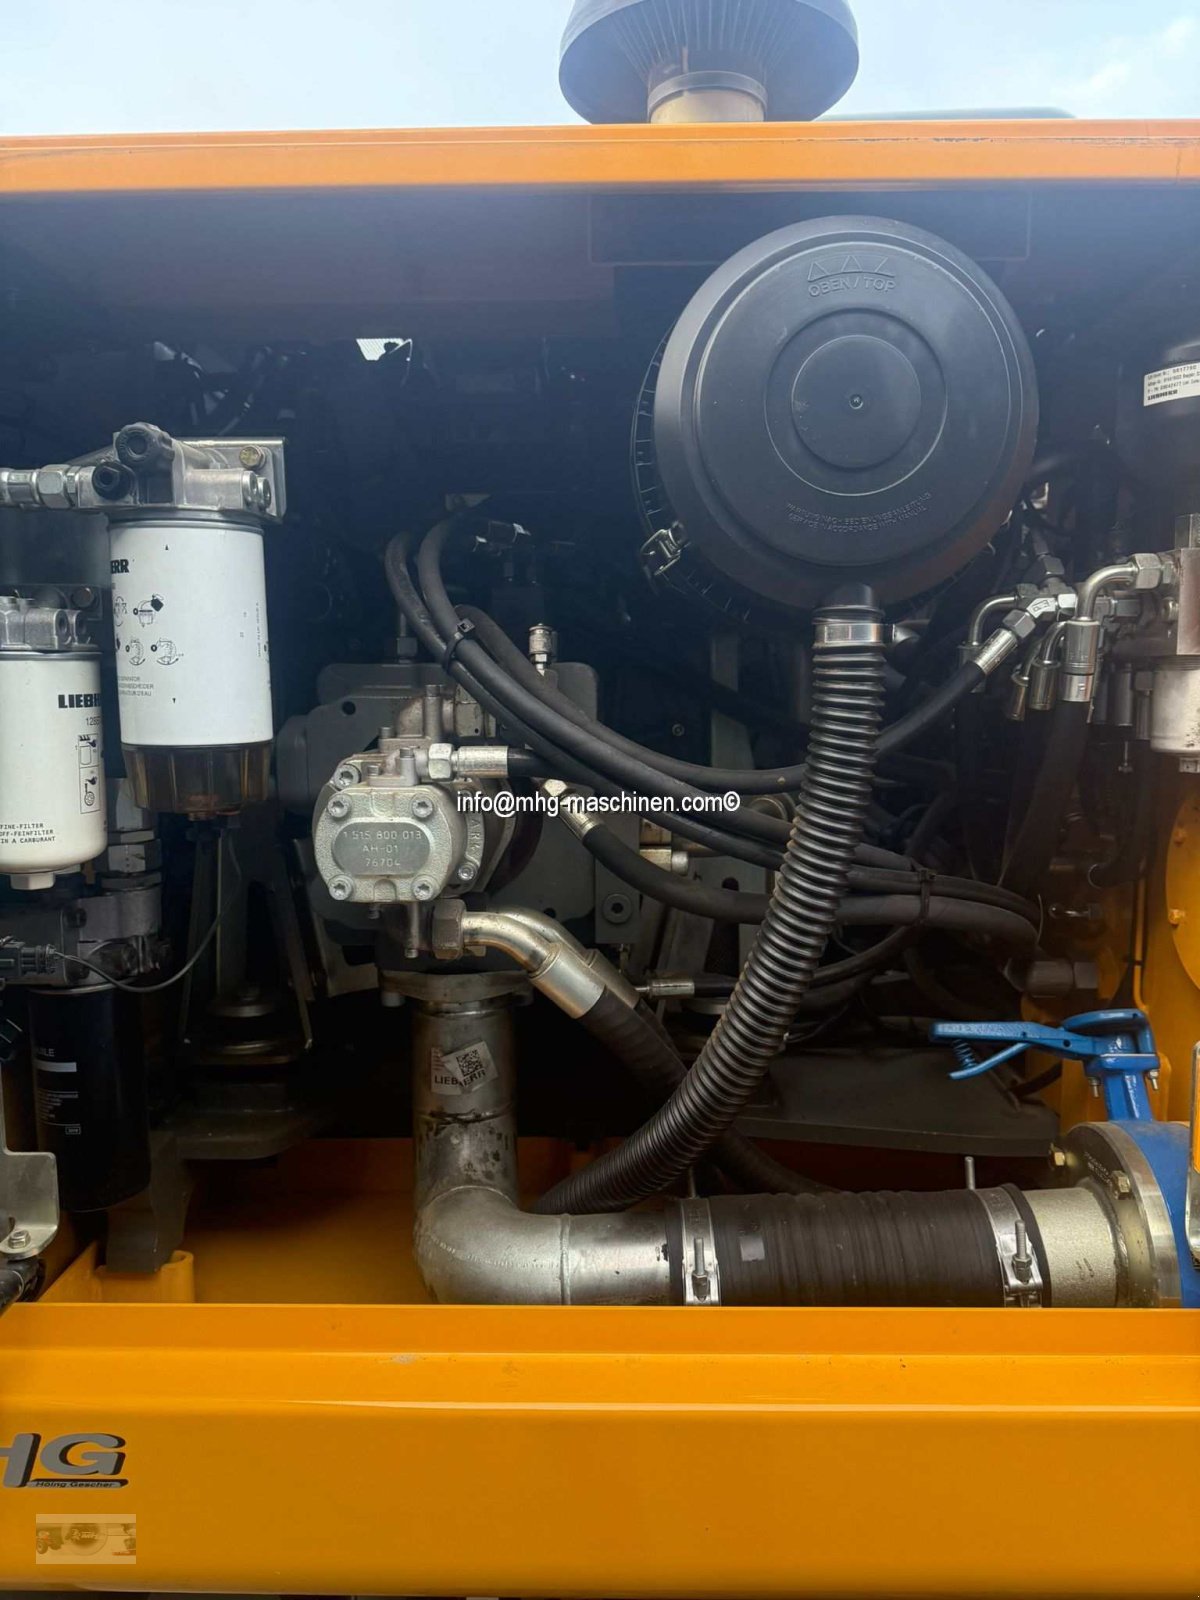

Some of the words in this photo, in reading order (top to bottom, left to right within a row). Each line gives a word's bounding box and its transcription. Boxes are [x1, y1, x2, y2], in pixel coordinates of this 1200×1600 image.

[808, 276, 851, 298] OBEN
[863, 274, 897, 292] TOP
[352, 831, 371, 840] 515
[376, 830, 398, 840] 800
[402, 830, 422, 840] 013
